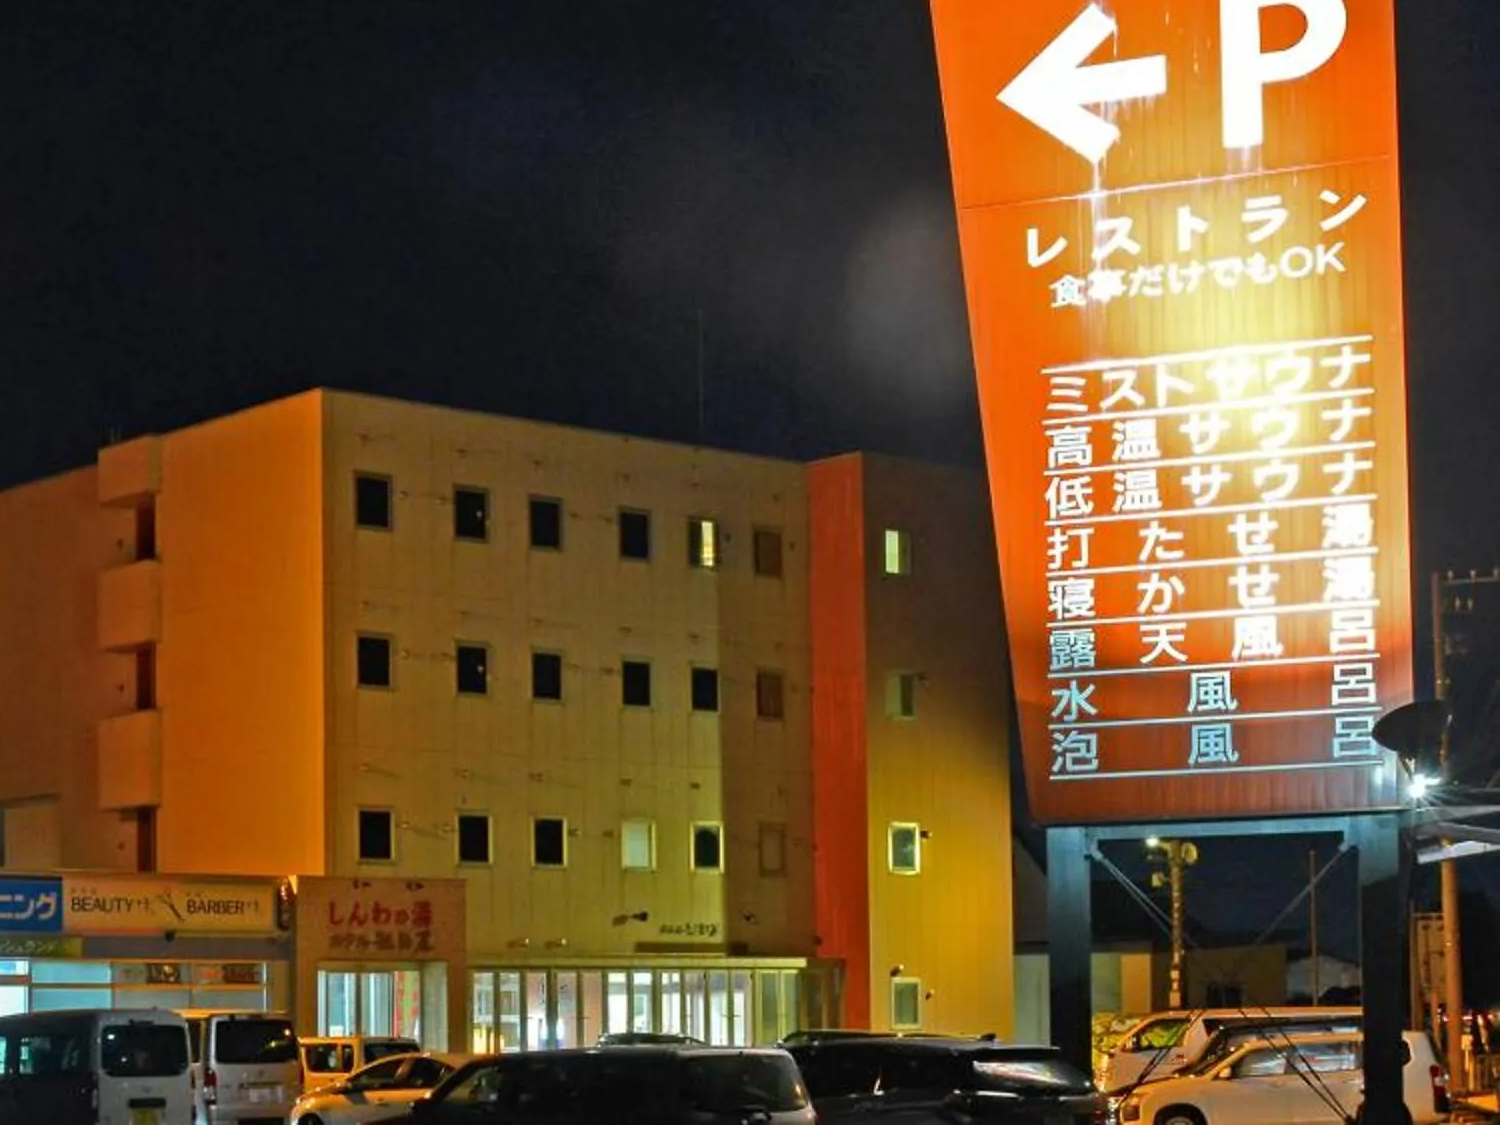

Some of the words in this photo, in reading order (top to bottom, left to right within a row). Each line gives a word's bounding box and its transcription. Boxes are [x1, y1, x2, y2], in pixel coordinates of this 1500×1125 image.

[1026, 190, 1368, 268] レストラン
[1049, 241, 1347, 309] 食事だけでもOK
[1045, 343, 1372, 413] ミストサウナ
[1044, 397, 1373, 470] 高温サウナ
[1044, 452, 1374, 520] 低温サウナ
[1049, 608, 1377, 671] 露天風呂
[1050, 661, 1377, 722] 水風呂
[1050, 714, 1380, 773] 泡風呂
[70, 896, 134, 913] BEAUTY
[186, 898, 245, 915] BARBER
